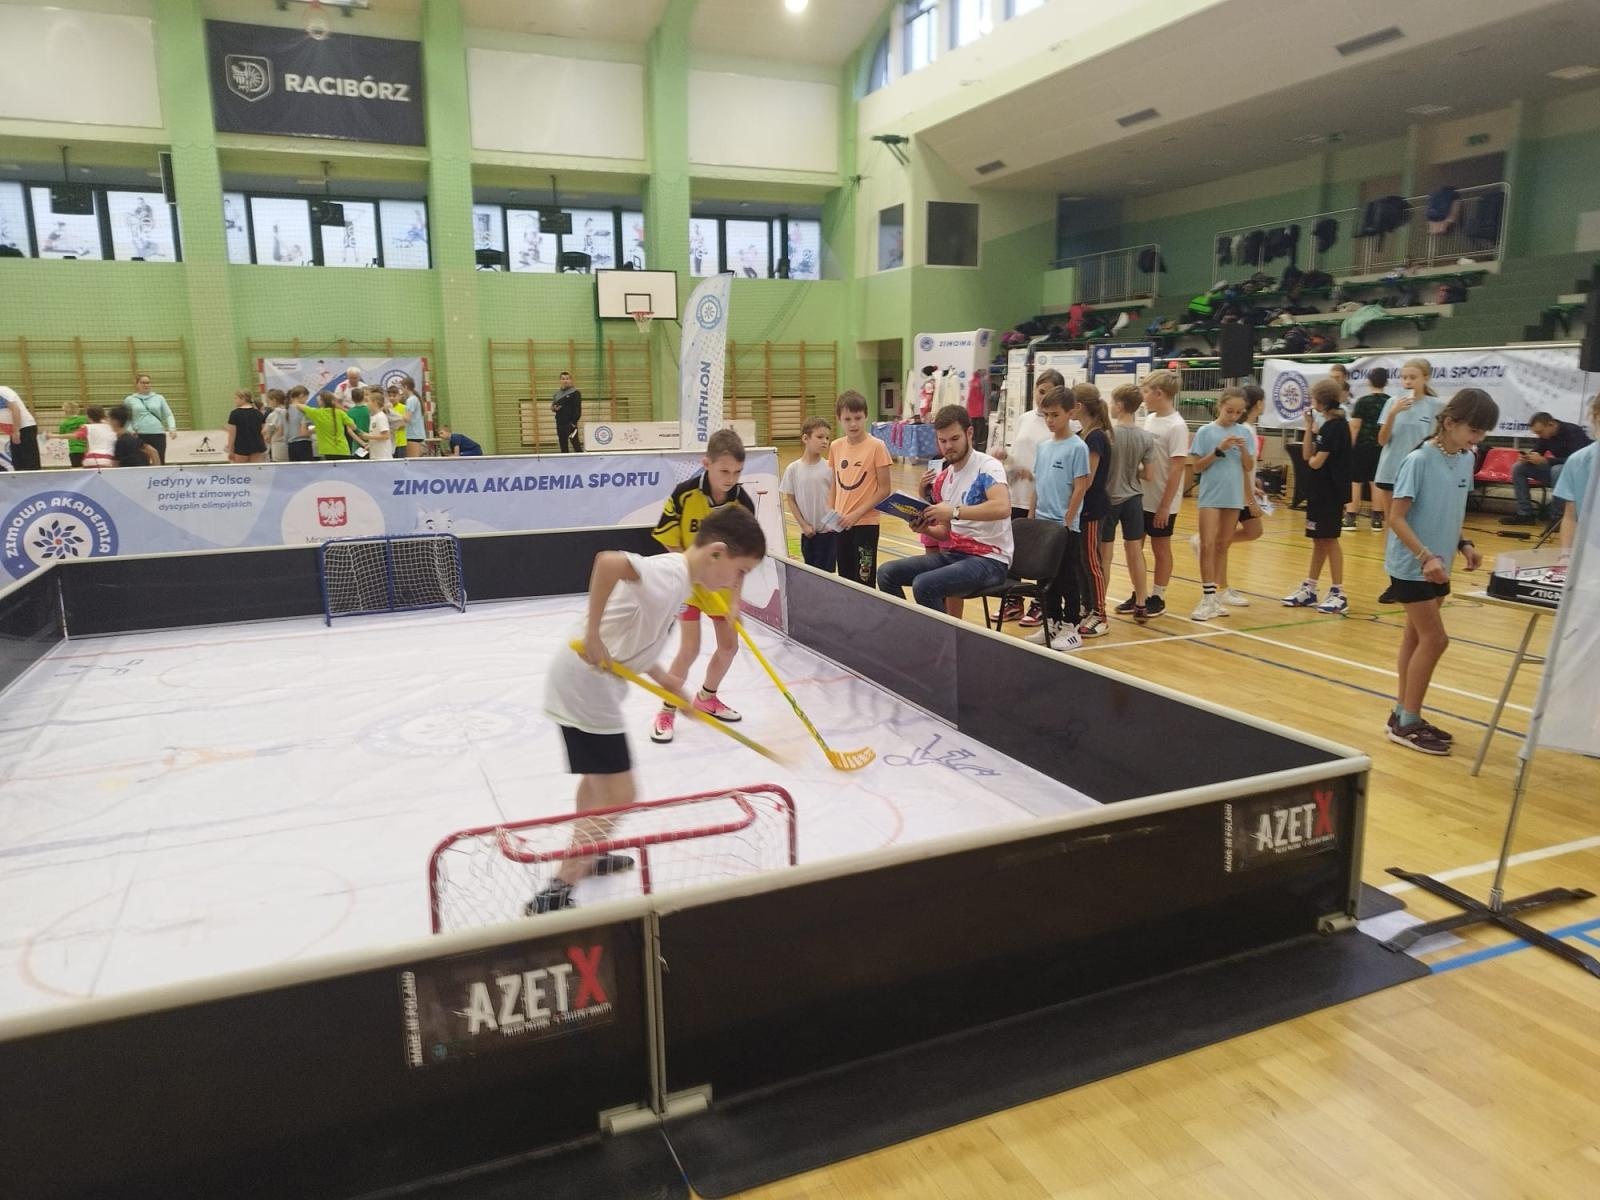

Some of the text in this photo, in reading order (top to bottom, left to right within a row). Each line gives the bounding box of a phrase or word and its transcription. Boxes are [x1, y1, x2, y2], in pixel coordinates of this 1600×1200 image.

[284, 73, 411, 102] RACIBÓRZ
[1450, 365, 1506, 379] SPORTU
[697, 361, 712, 443] BIATHLON
[147, 474, 252, 490] jedyny w Polsce
[158, 489, 251, 502] projekt zimowych
[392, 471, 660, 496] ZIMOWA AKADEMIA SPORTU
[158, 502, 200, 512] dyscyplin
[6, 497, 111, 558] ZIMOWA AKADEMIA
[1251, 789, 1334, 851] AZETX
[455, 945, 608, 1036] AZETX
